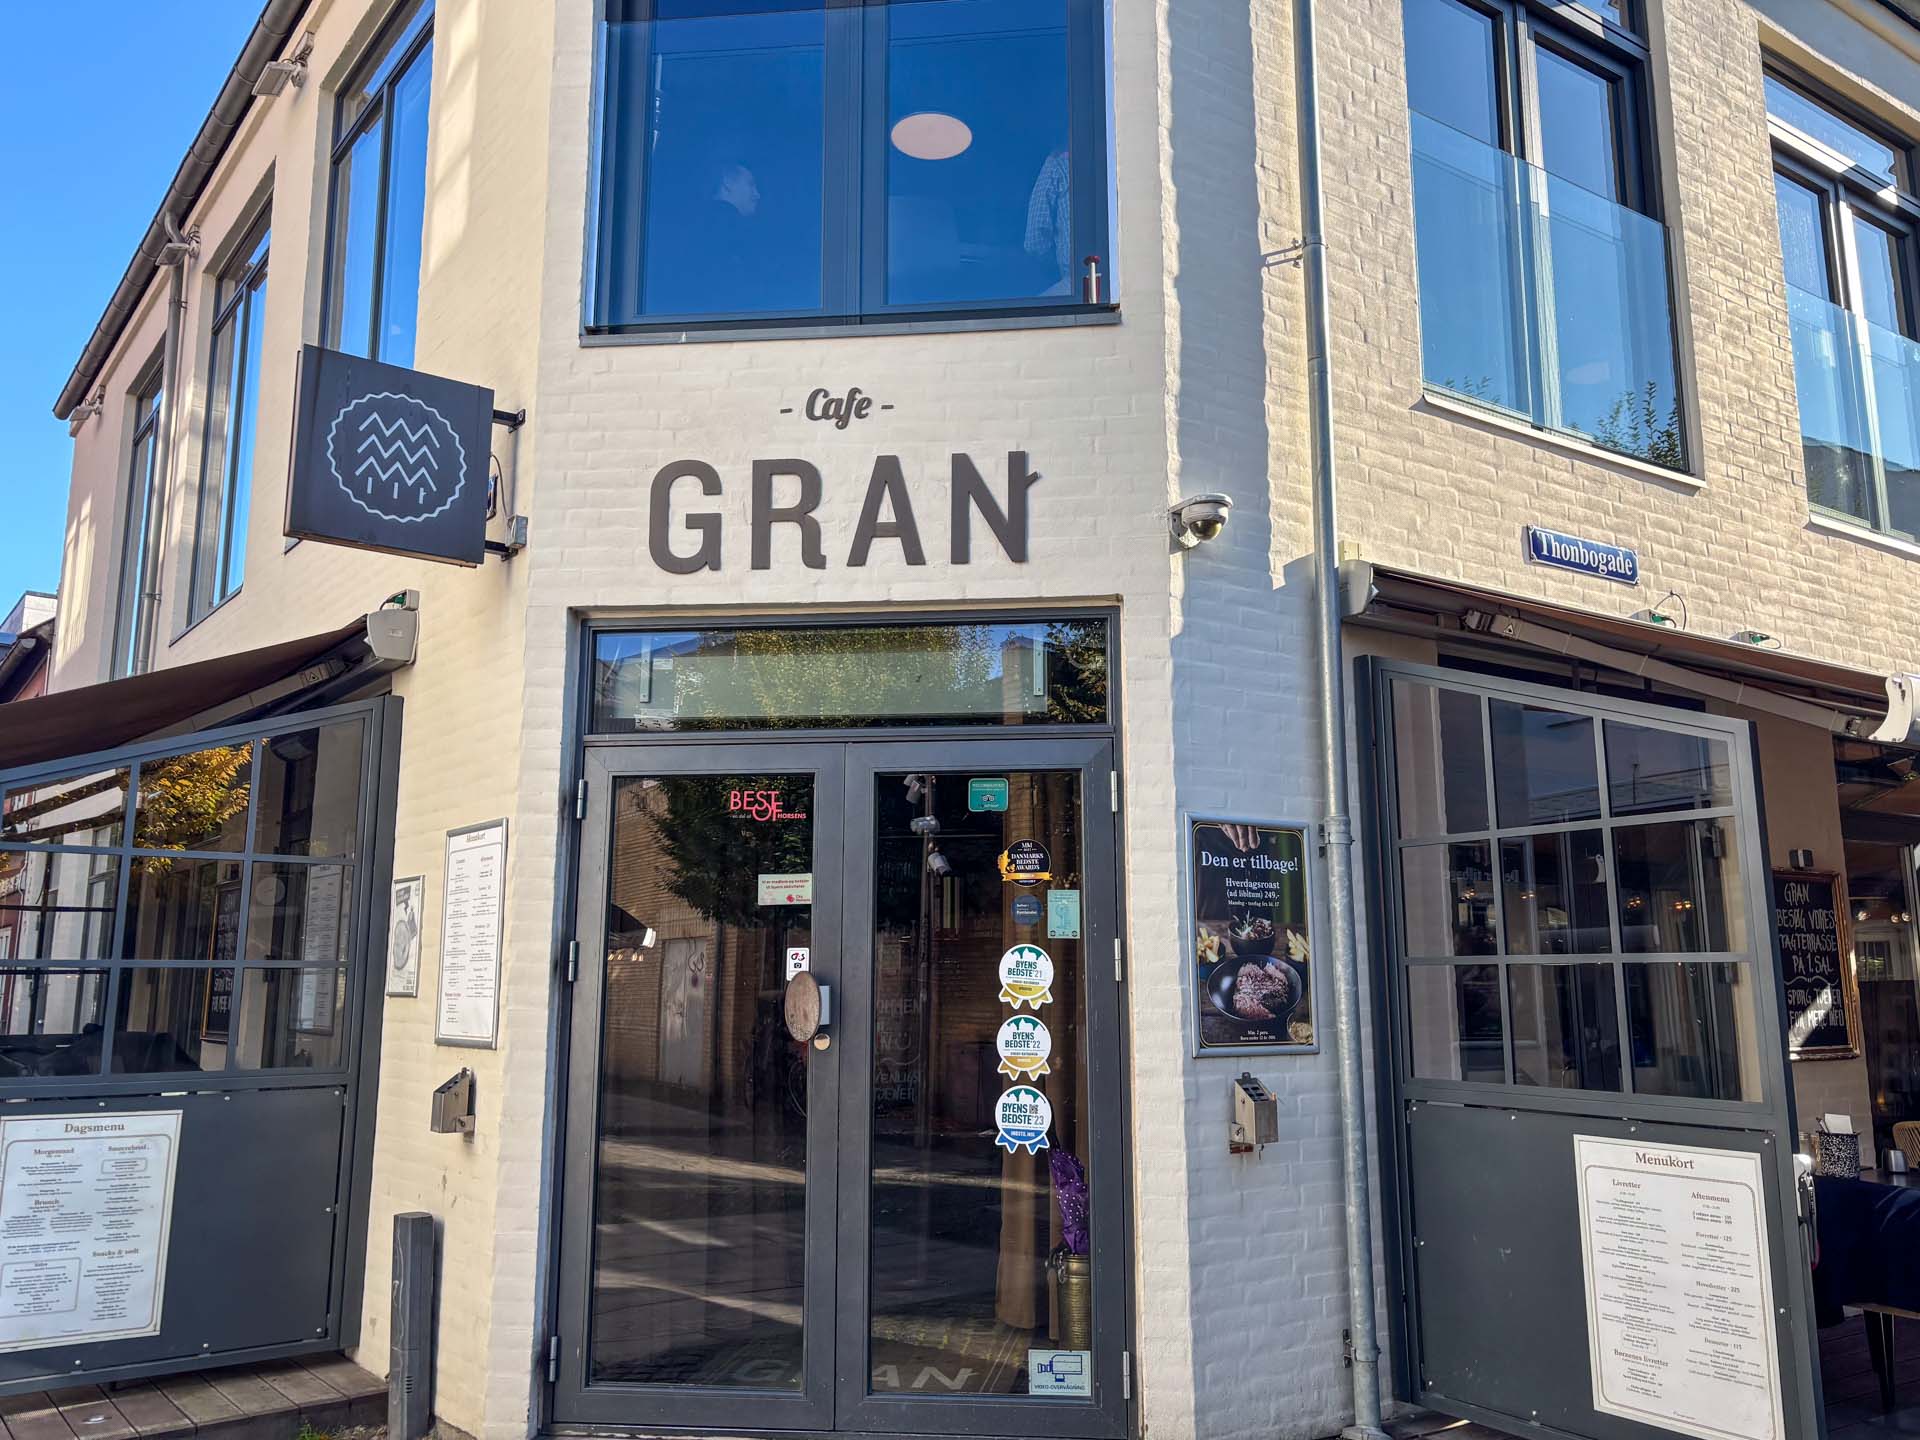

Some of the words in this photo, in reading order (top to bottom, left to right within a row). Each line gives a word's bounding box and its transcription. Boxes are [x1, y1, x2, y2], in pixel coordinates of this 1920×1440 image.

[806, 387, 873, 430] Cafe
[648, 450, 1041, 575] GRAN
[1536, 530, 1633, 575] Thonbogade
[731, 791, 779, 810] BEST
[1201, 851, 1229, 867] Den
[1232, 857, 1246, 868] er
[1250, 854, 1298, 874] tilbage!
[1226, 878, 1280, 890] Hverdagsroast
[1227, 889, 1237, 899] (ad
[1264, 891, 1280, 899] 249,-
[1784, 882, 1810, 906] GRAN
[1776, 908, 1806, 931] BESØG
[1808, 908, 1834, 932] VORES
[1780, 933, 1837, 952] TAGTERRASSE
[1015, 960, 1037, 969] BYENS
[1792, 952, 1806, 974] PÅ
[1788, 989, 1811, 1006] SPØRG
[1790, 1010, 1806, 1030] FOR
[1807, 1009, 1827, 1029] MERE
[1012, 1032, 1034, 1040] BYENS
[1002, 1103, 1028, 1113] BYENS
[64, 1123, 125, 1134] Dagsmenu
[1635, 1152, 1695, 1169] Menukort
[1612, 1179, 1641, 1189] Livretter
[1691, 1192, 1730, 1203] Aftenmenu
[1696, 1281, 1726, 1292] Hovedretter
[1643, 1355, 1669, 1367] livretter
